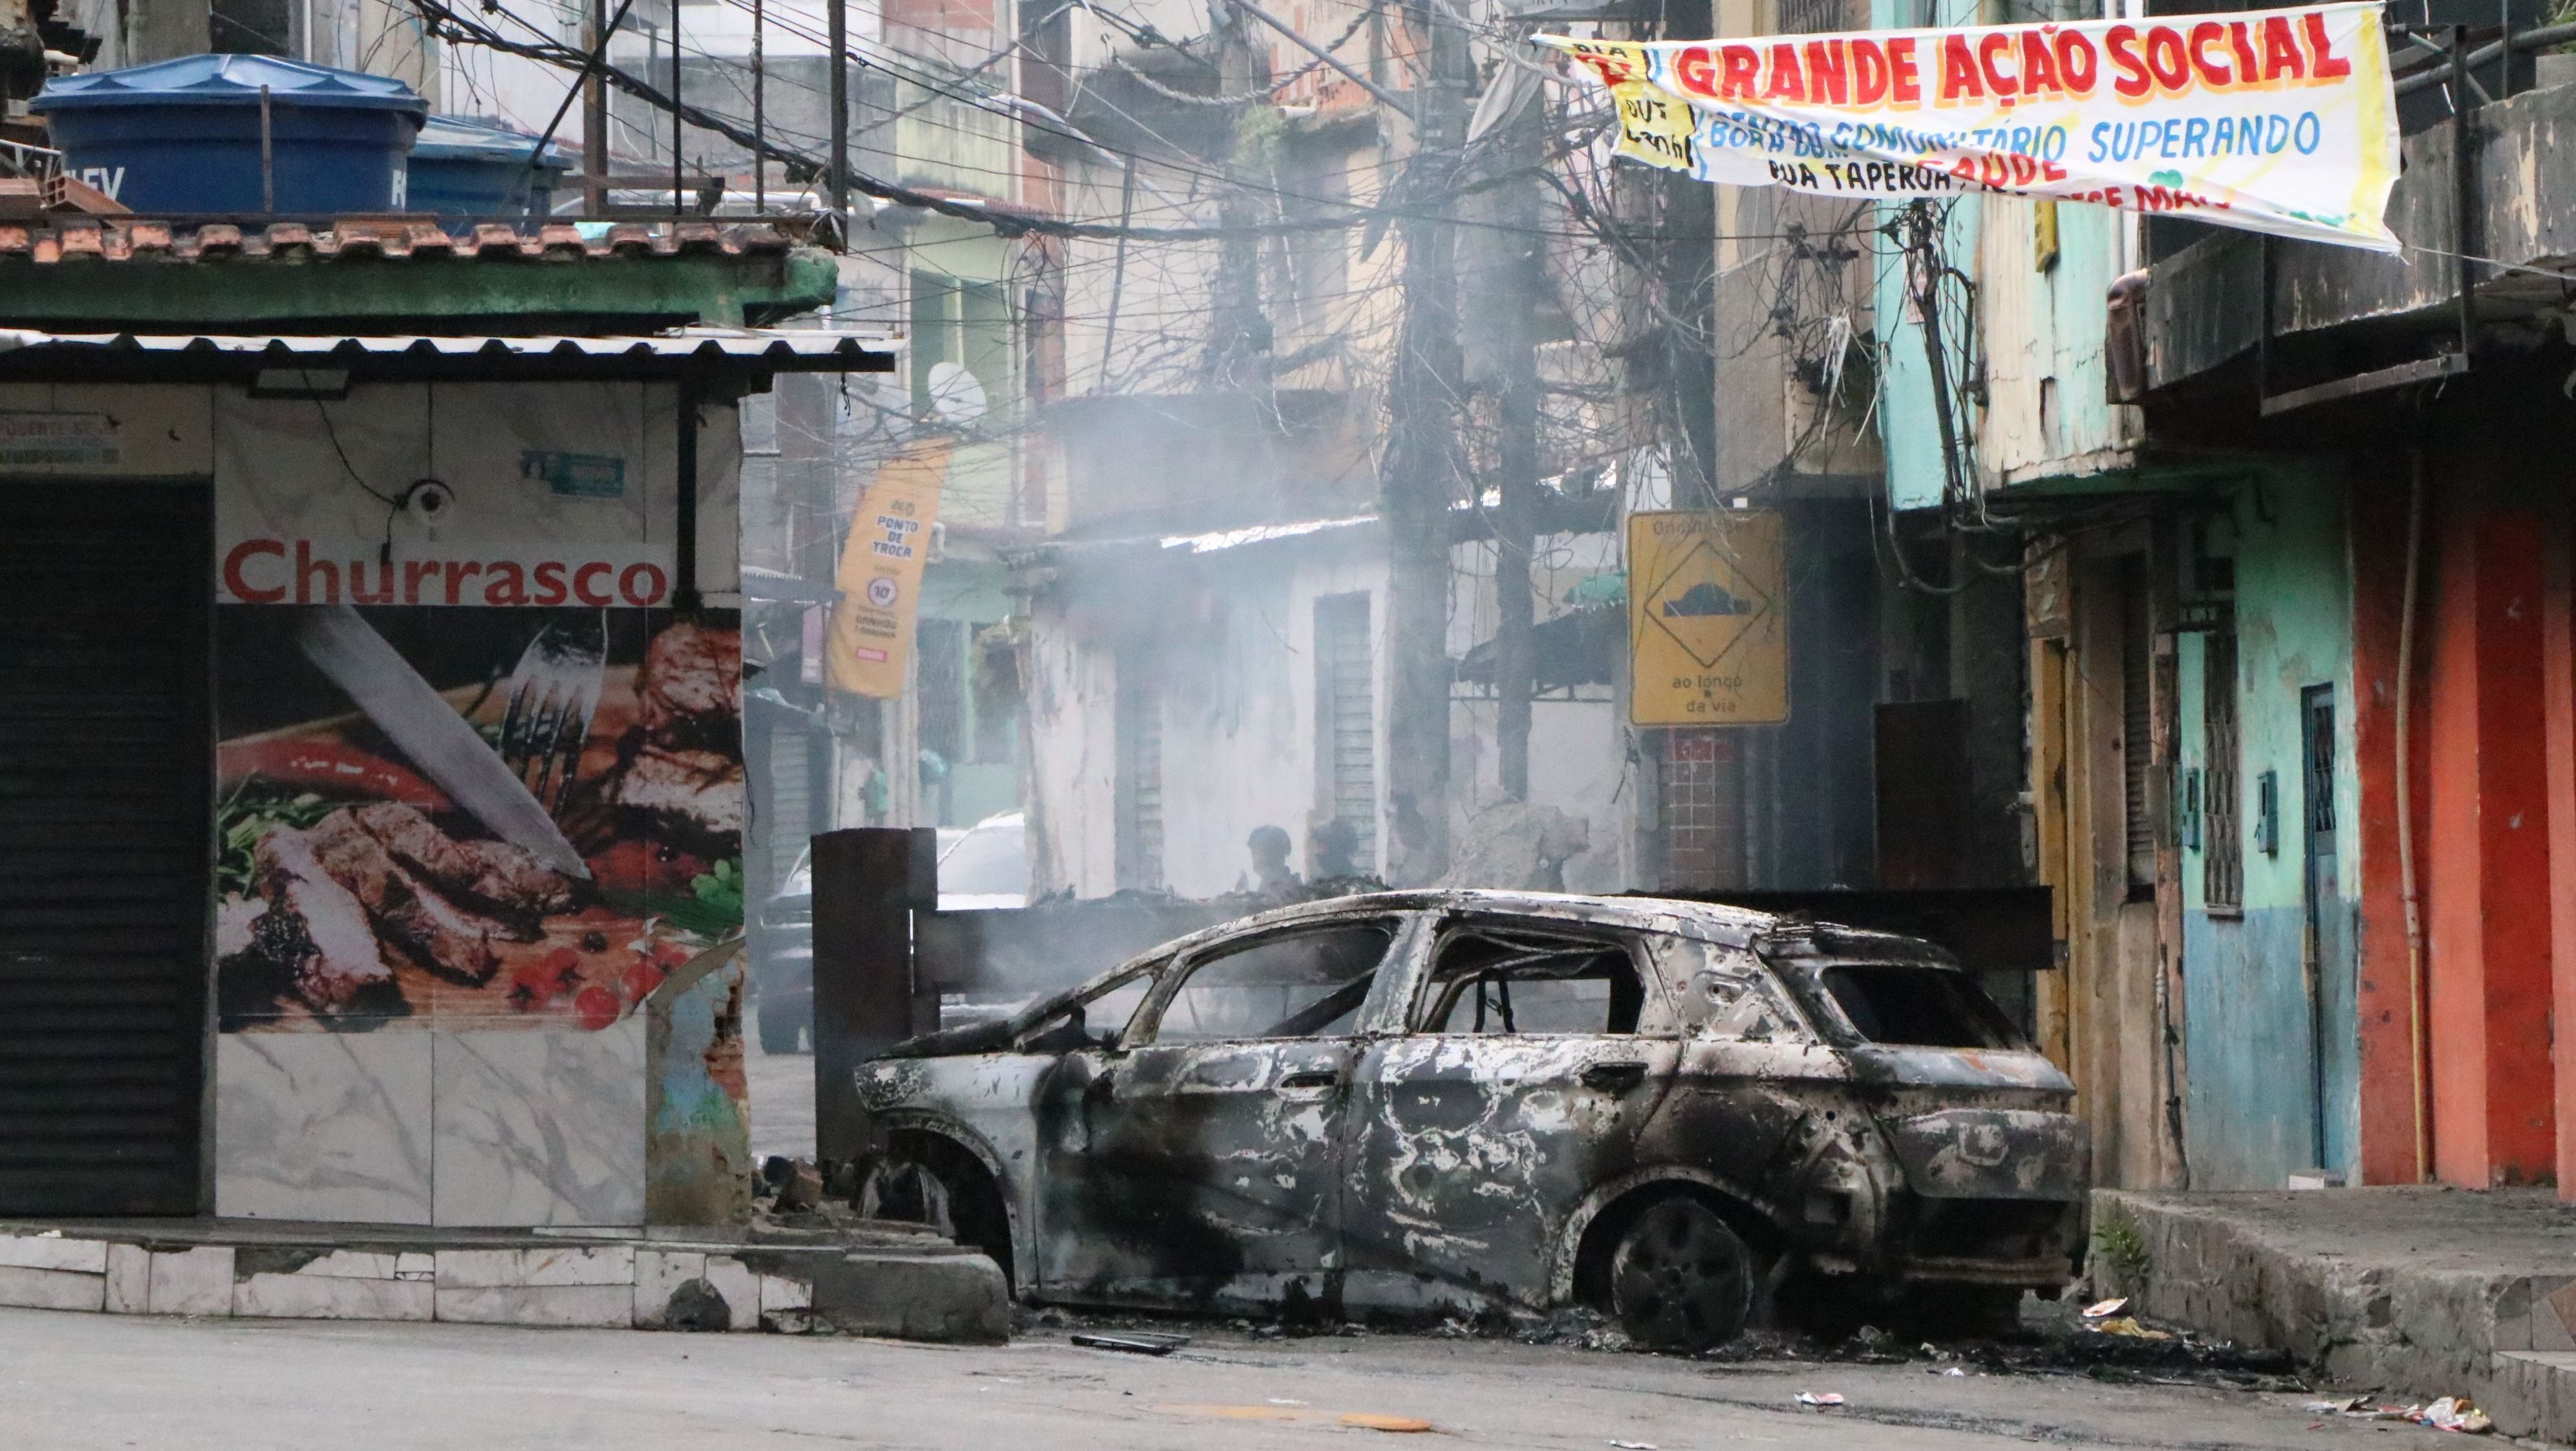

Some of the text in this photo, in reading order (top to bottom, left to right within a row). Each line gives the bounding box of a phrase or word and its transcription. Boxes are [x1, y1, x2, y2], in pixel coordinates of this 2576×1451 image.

[1676, 38, 1921, 107] GRANDE
[1940, 24, 2098, 107] AÇÃO
[2105, 12, 2352, 98] SOCIAL
[2088, 111, 2321, 163] SUPERANDO
[1916, 149, 2067, 188] AÚDE
[877, 515, 919, 533] PONTO
[887, 530, 903, 544] DE
[873, 541, 912, 558] TROCA
[223, 539, 667, 607] Churrasco
[874, 585, 891, 599] 10
[1672, 674, 1743, 692] ao longo
[1686, 701, 1736, 712] da via
